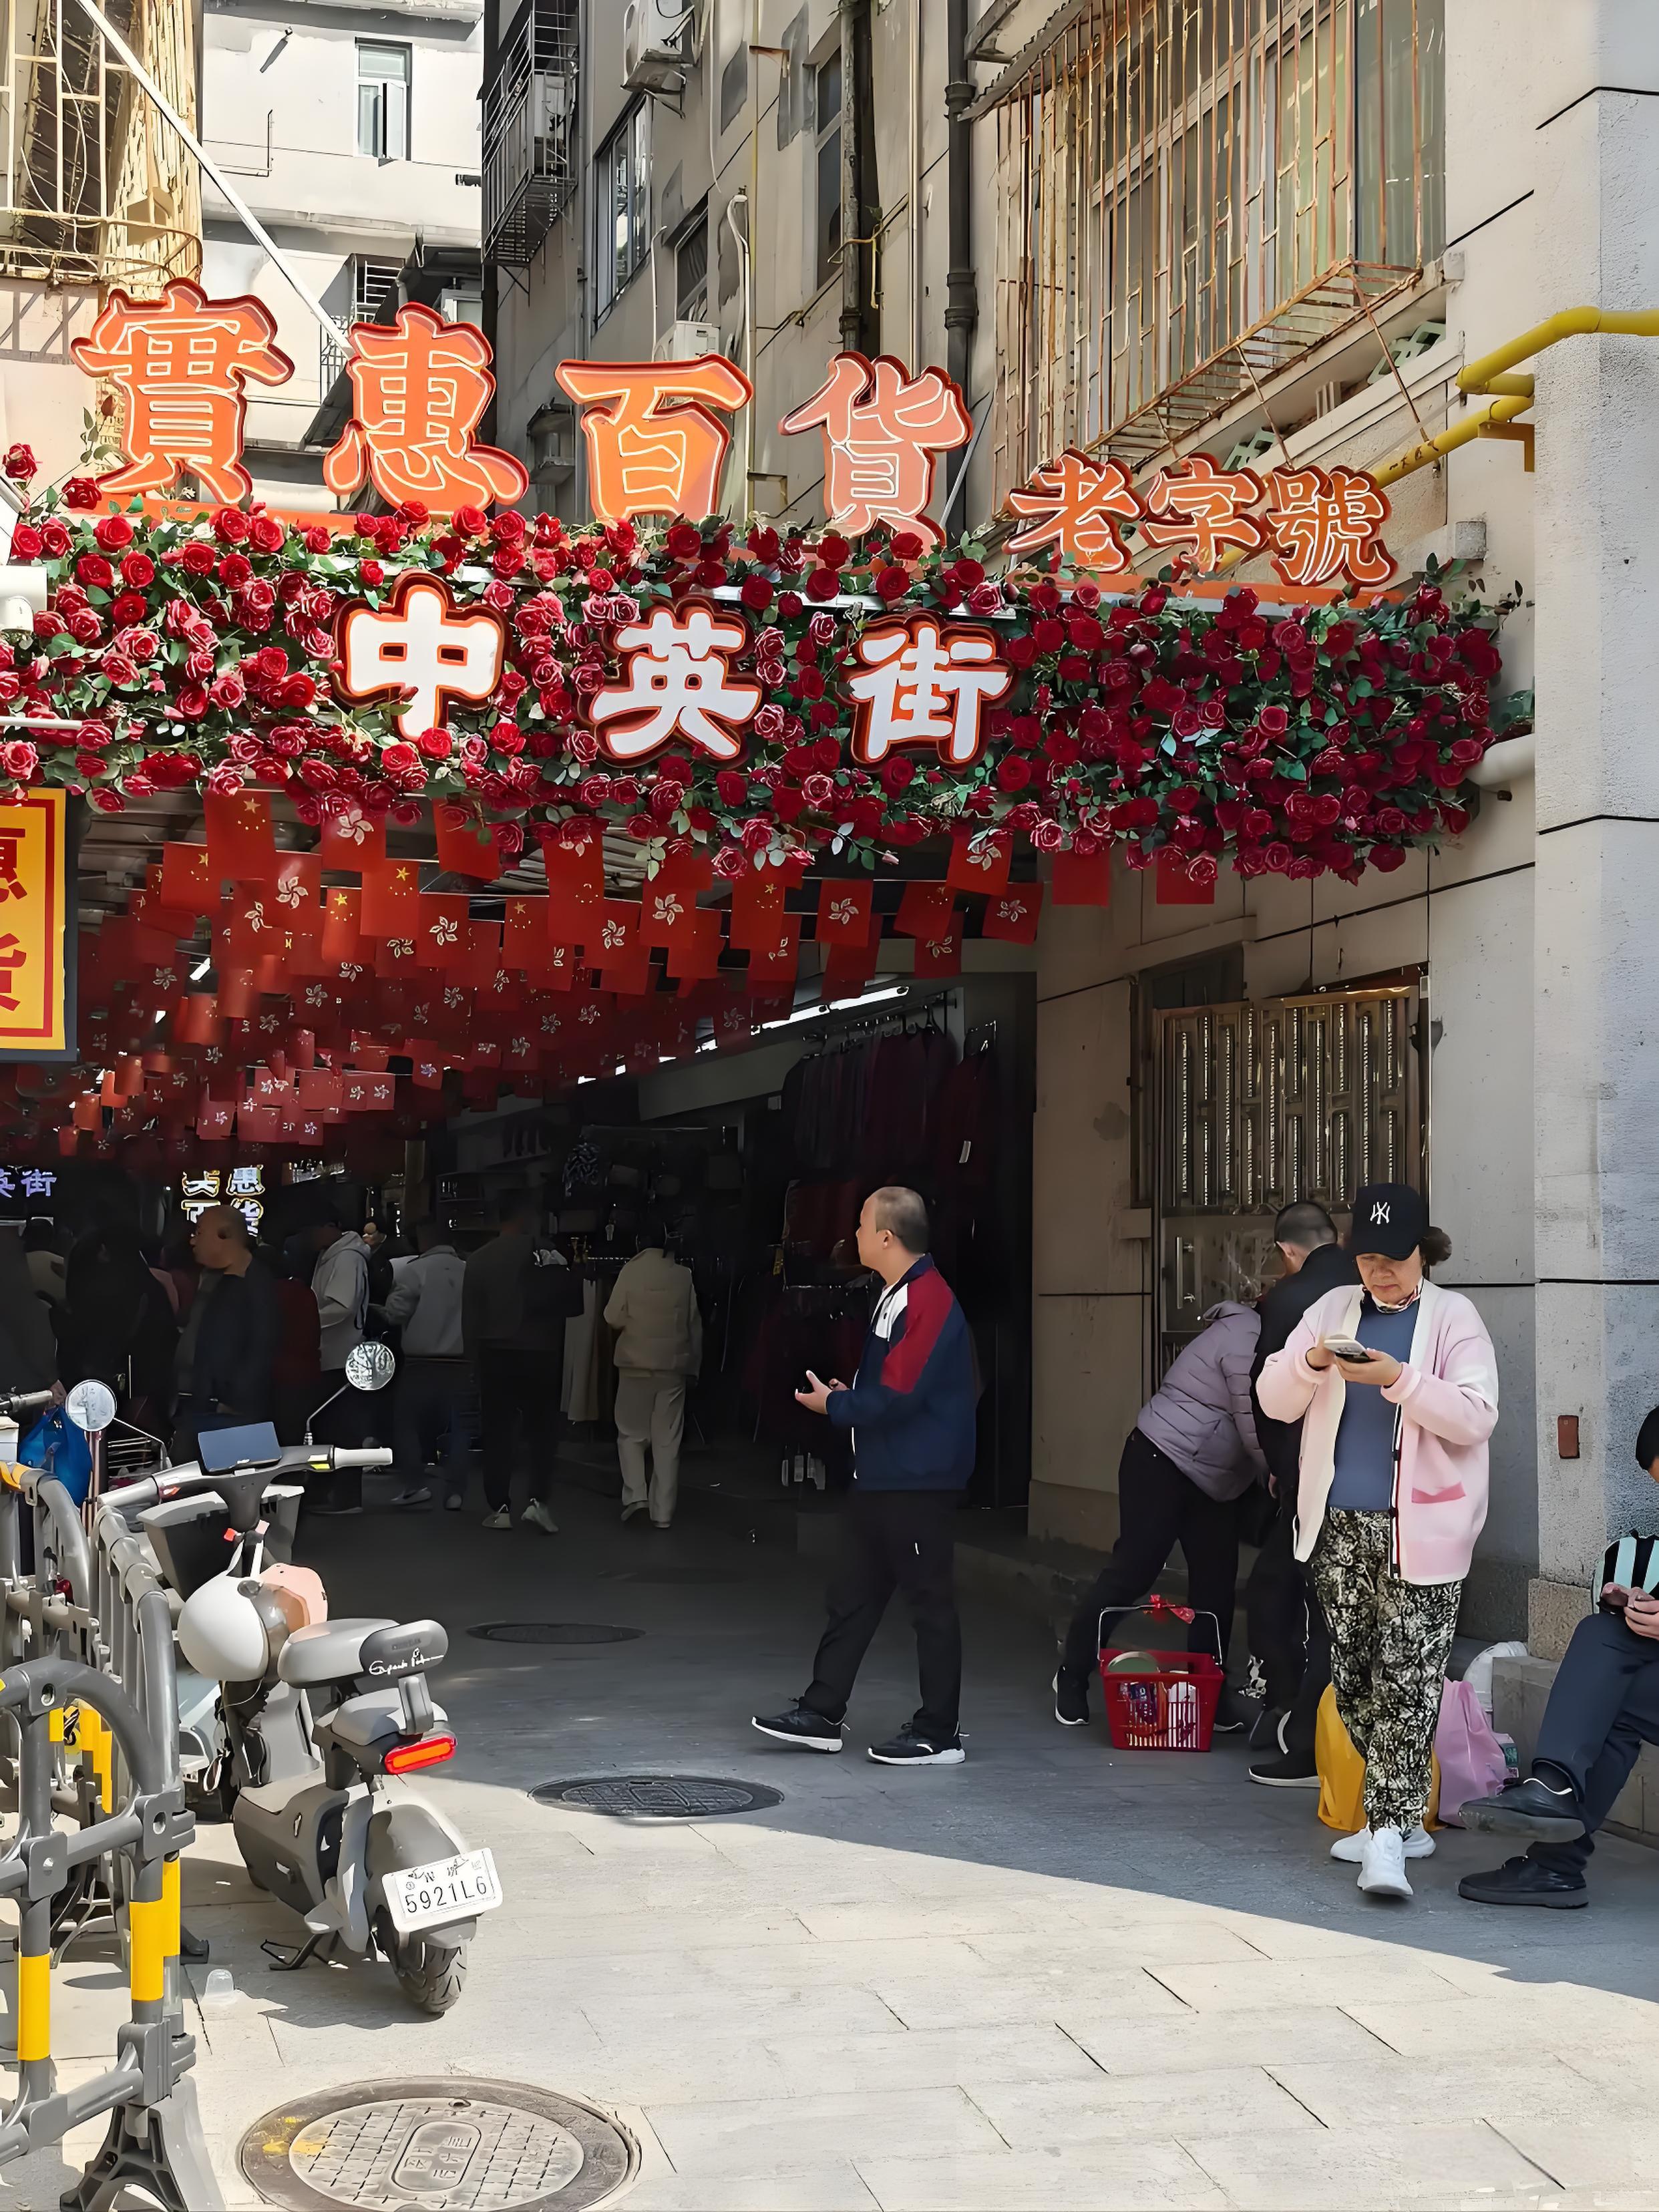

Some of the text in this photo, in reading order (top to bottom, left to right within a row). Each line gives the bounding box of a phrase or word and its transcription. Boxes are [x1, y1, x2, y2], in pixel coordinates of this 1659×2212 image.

[71, 278, 974, 549] 實惠百貨
[1002, 448, 1397, 588] 老字號
[341, 578, 1012, 767] 中英街
[405, 1875, 488, 1914] 5921L6
